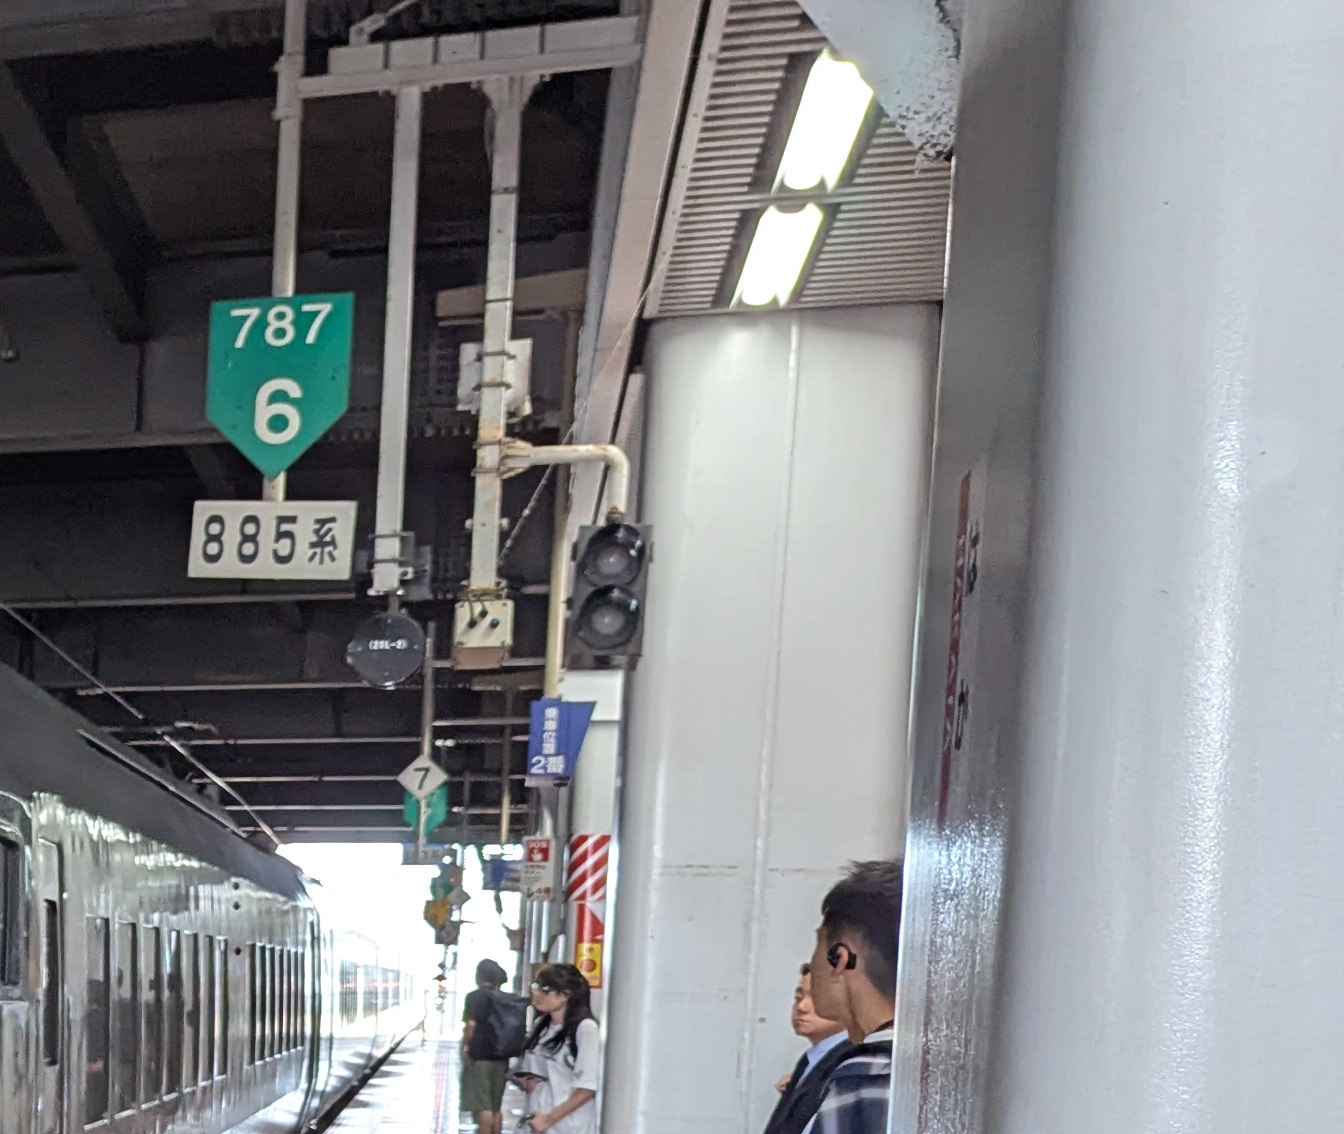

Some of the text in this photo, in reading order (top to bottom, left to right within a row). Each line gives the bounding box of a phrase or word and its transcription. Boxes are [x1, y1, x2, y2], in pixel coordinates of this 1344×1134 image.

[229, 303, 332, 349] 787
[253, 377, 303, 445] 6
[200, 514, 339, 566] 885系
[413, 766, 431, 791] 7
[530, 755, 565, 775] 2番
